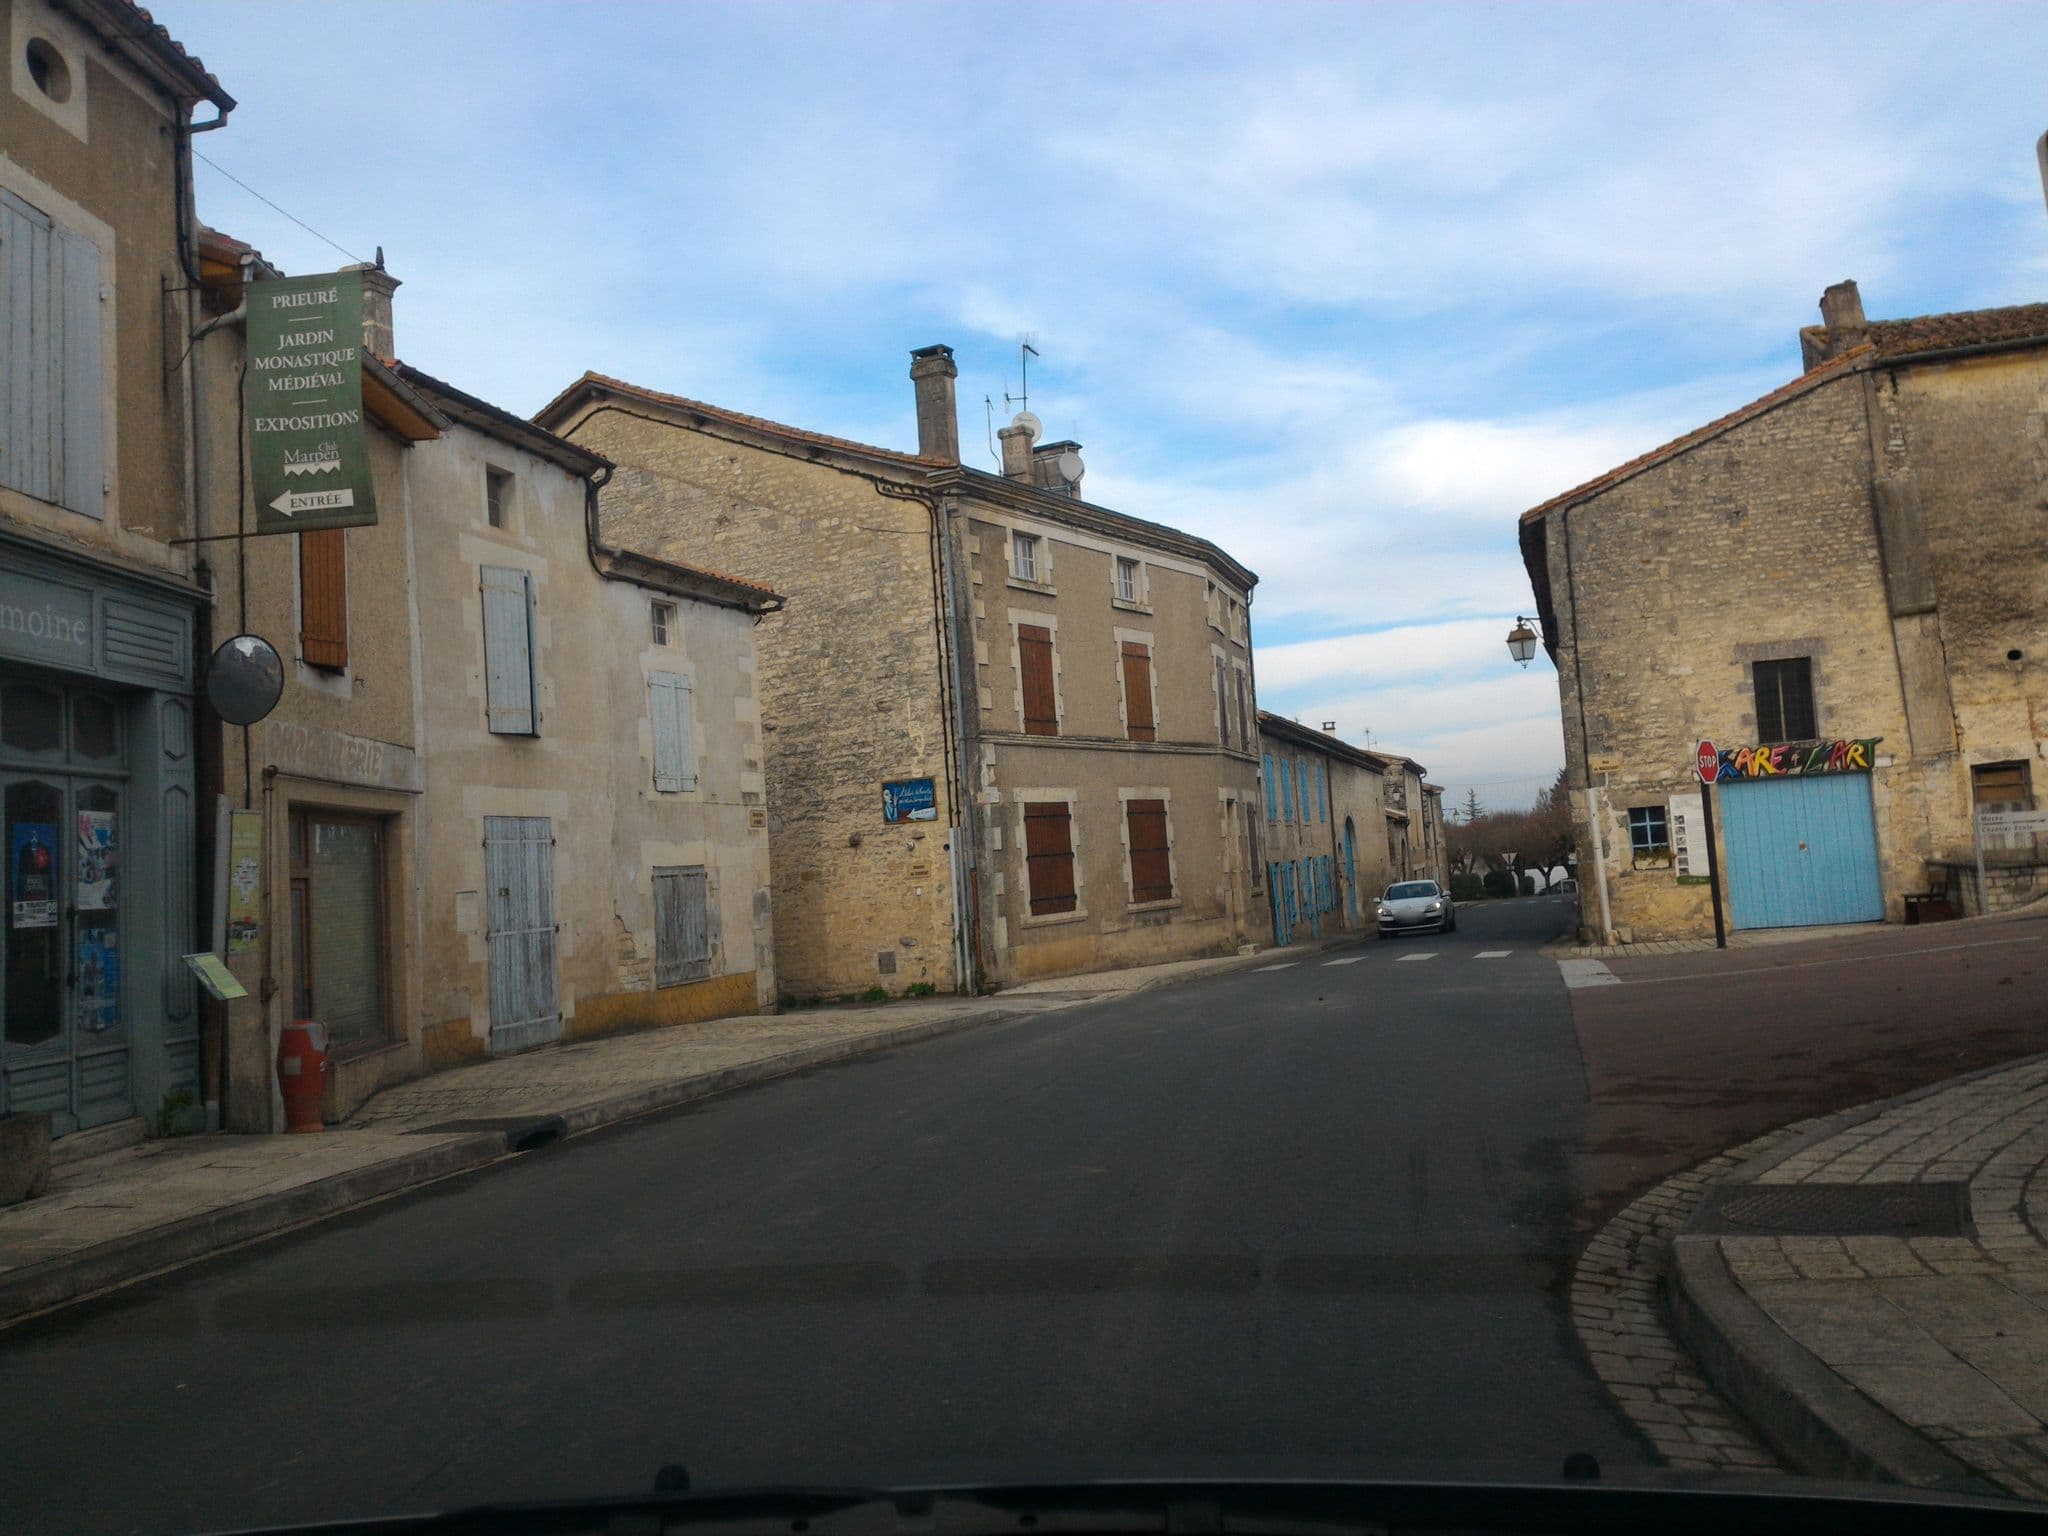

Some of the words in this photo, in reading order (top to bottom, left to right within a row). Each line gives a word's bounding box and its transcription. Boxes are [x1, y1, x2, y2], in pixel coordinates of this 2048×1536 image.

[272, 287, 338, 309] PRIEURÉ
[277, 329, 334, 350] JARDIN
[255, 348, 355, 371] MONASTIQUE
[268, 371, 345, 391] MÉDIÉVAL
[255, 409, 359, 432] EXPOSITIONS
[284, 449, 340, 465] Marpen
[290, 491, 342, 509] ENTRÉE
[1699, 755, 1717, 769] STOP
